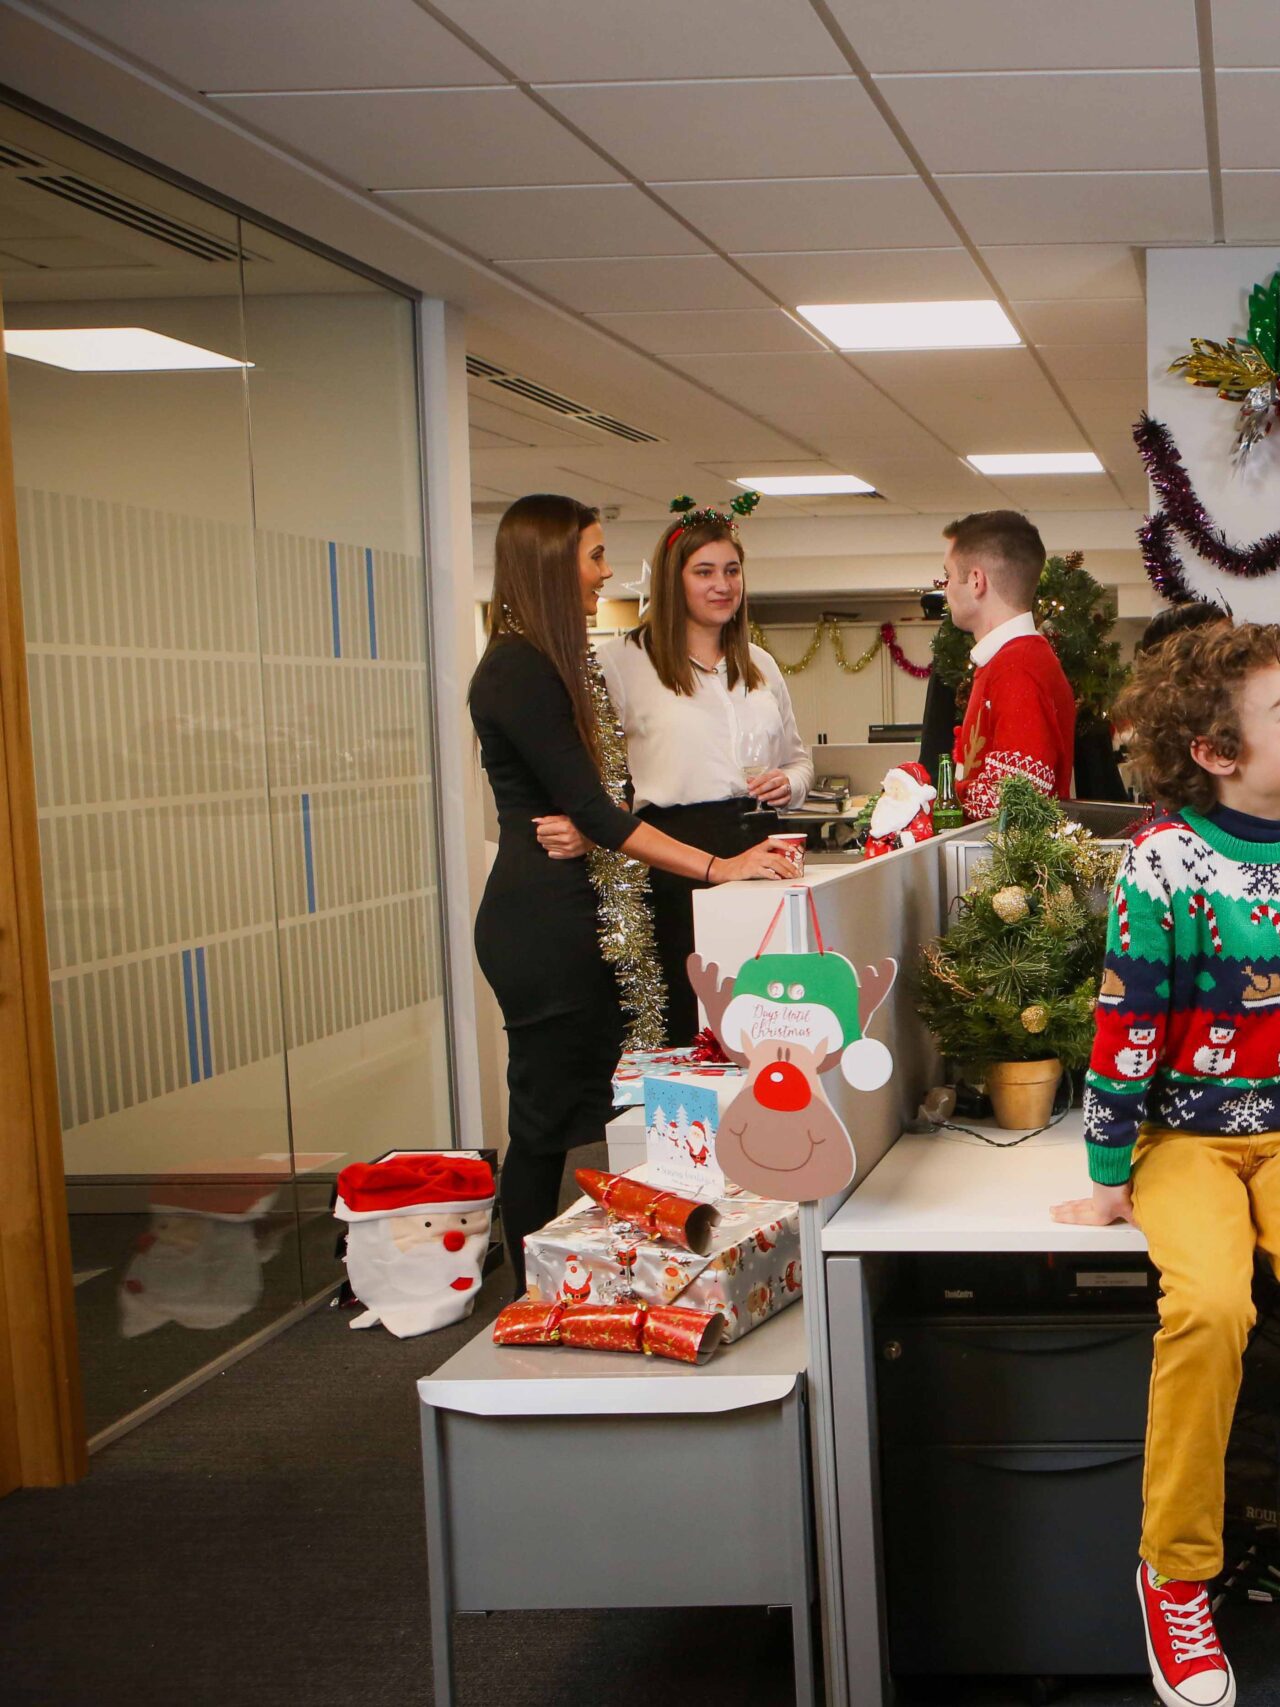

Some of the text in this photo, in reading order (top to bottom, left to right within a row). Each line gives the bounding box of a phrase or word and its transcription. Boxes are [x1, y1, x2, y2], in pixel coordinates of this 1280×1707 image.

[753, 1004, 811, 1022] Days Until
[751, 1019, 811, 1039] Christmas
